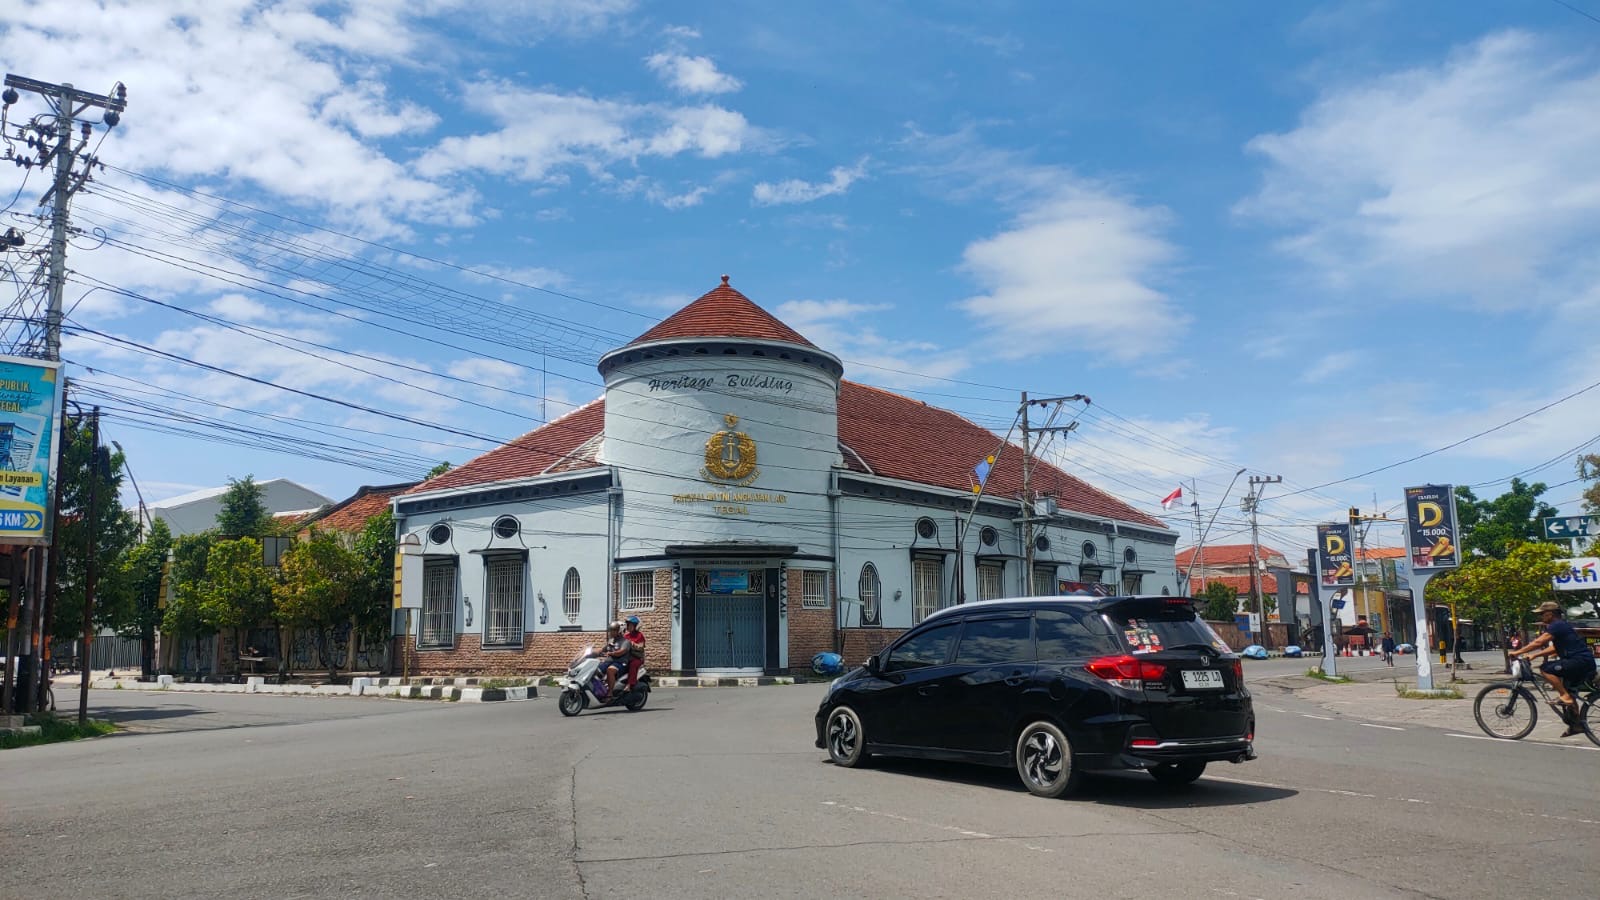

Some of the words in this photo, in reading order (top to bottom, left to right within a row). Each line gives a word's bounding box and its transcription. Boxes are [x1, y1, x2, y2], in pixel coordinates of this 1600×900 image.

[647, 376, 714, 392] Heritage
[726, 374, 793, 393] Building
[5, 474, 33, 484] Layanan
[4, 512, 21, 527] KM
[1418, 502, 1442, 527] D
[1422, 528, 1446, 536] 15.000
[1326, 535, 1345, 555] D
